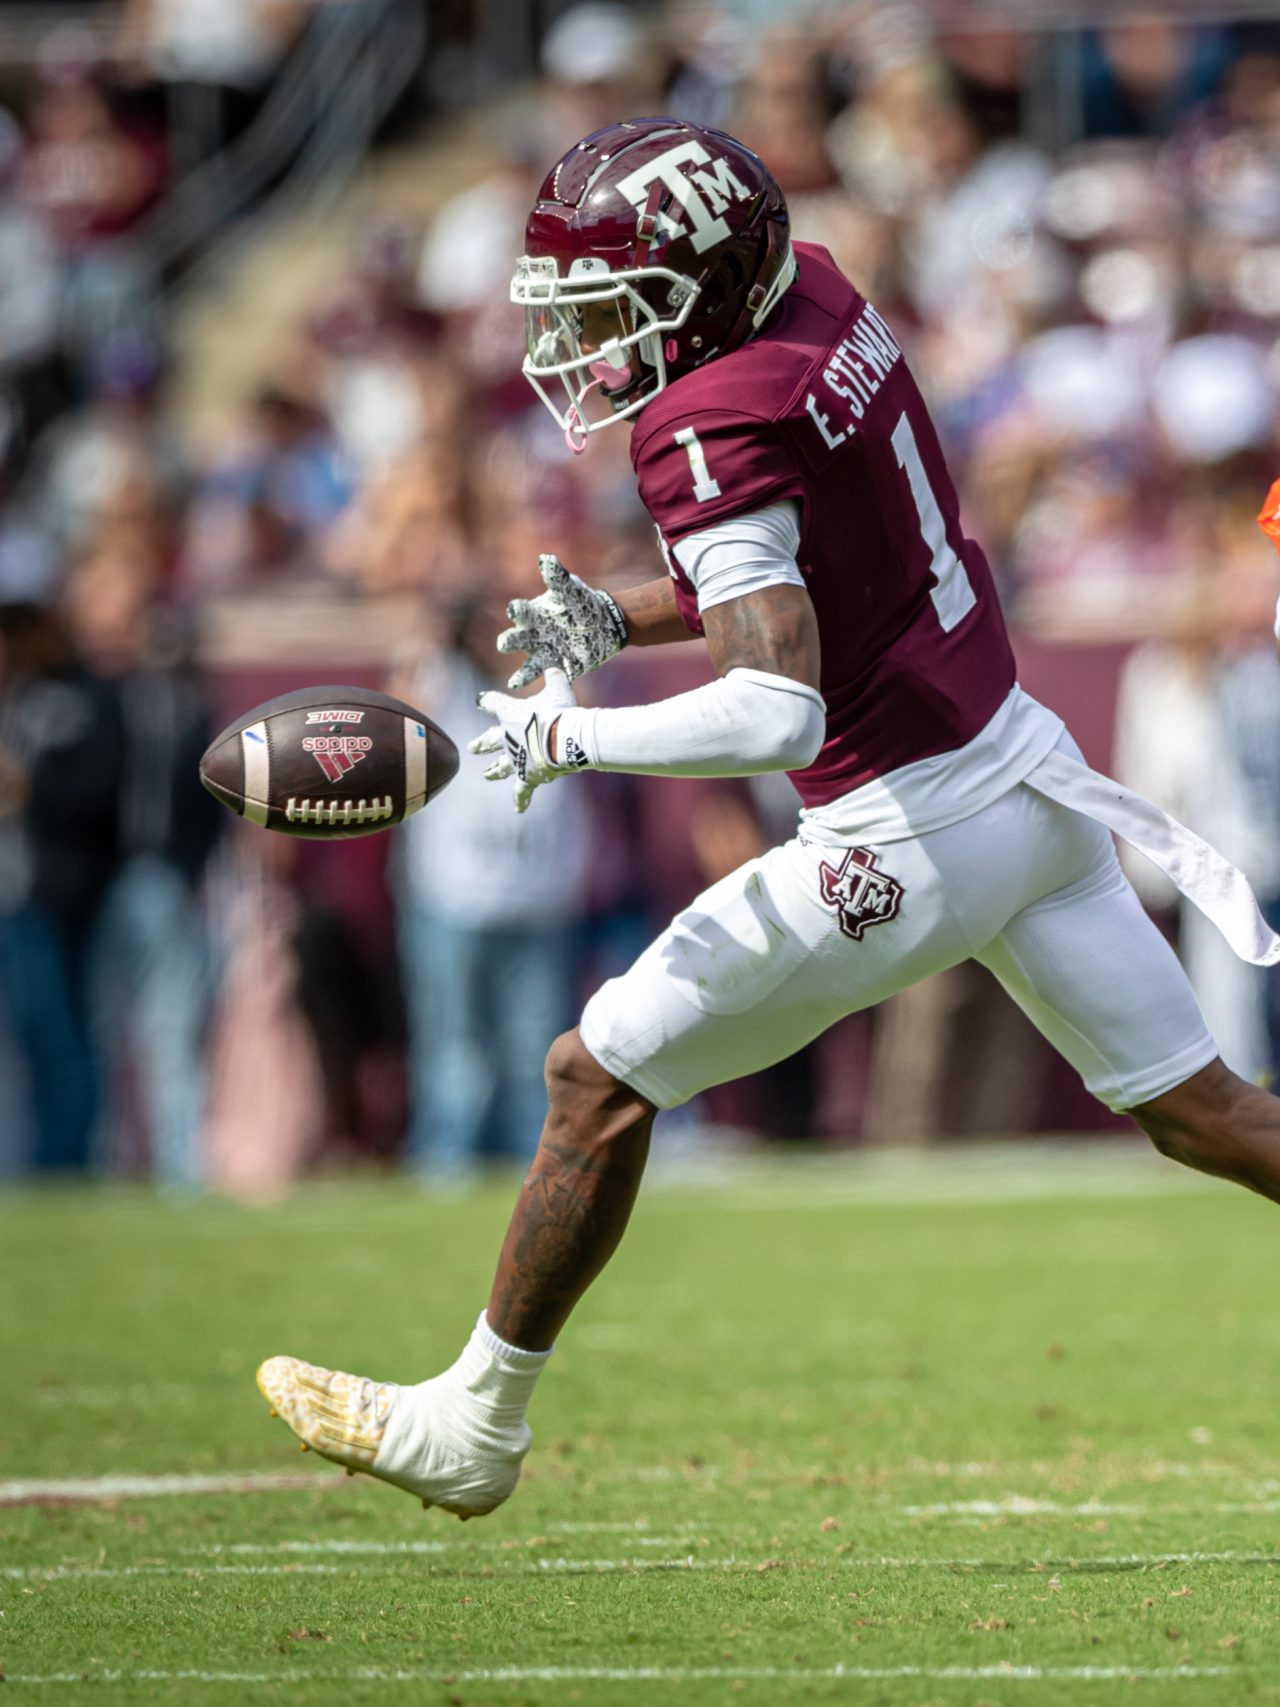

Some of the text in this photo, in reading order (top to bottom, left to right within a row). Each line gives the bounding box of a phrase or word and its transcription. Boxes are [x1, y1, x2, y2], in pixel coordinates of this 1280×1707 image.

[806, 393, 856, 451] E.
[672, 426, 722, 503] 1
[891, 411, 977, 633] 1
[302, 736, 372, 751] adidas
[306, 711, 365, 724] DIME
